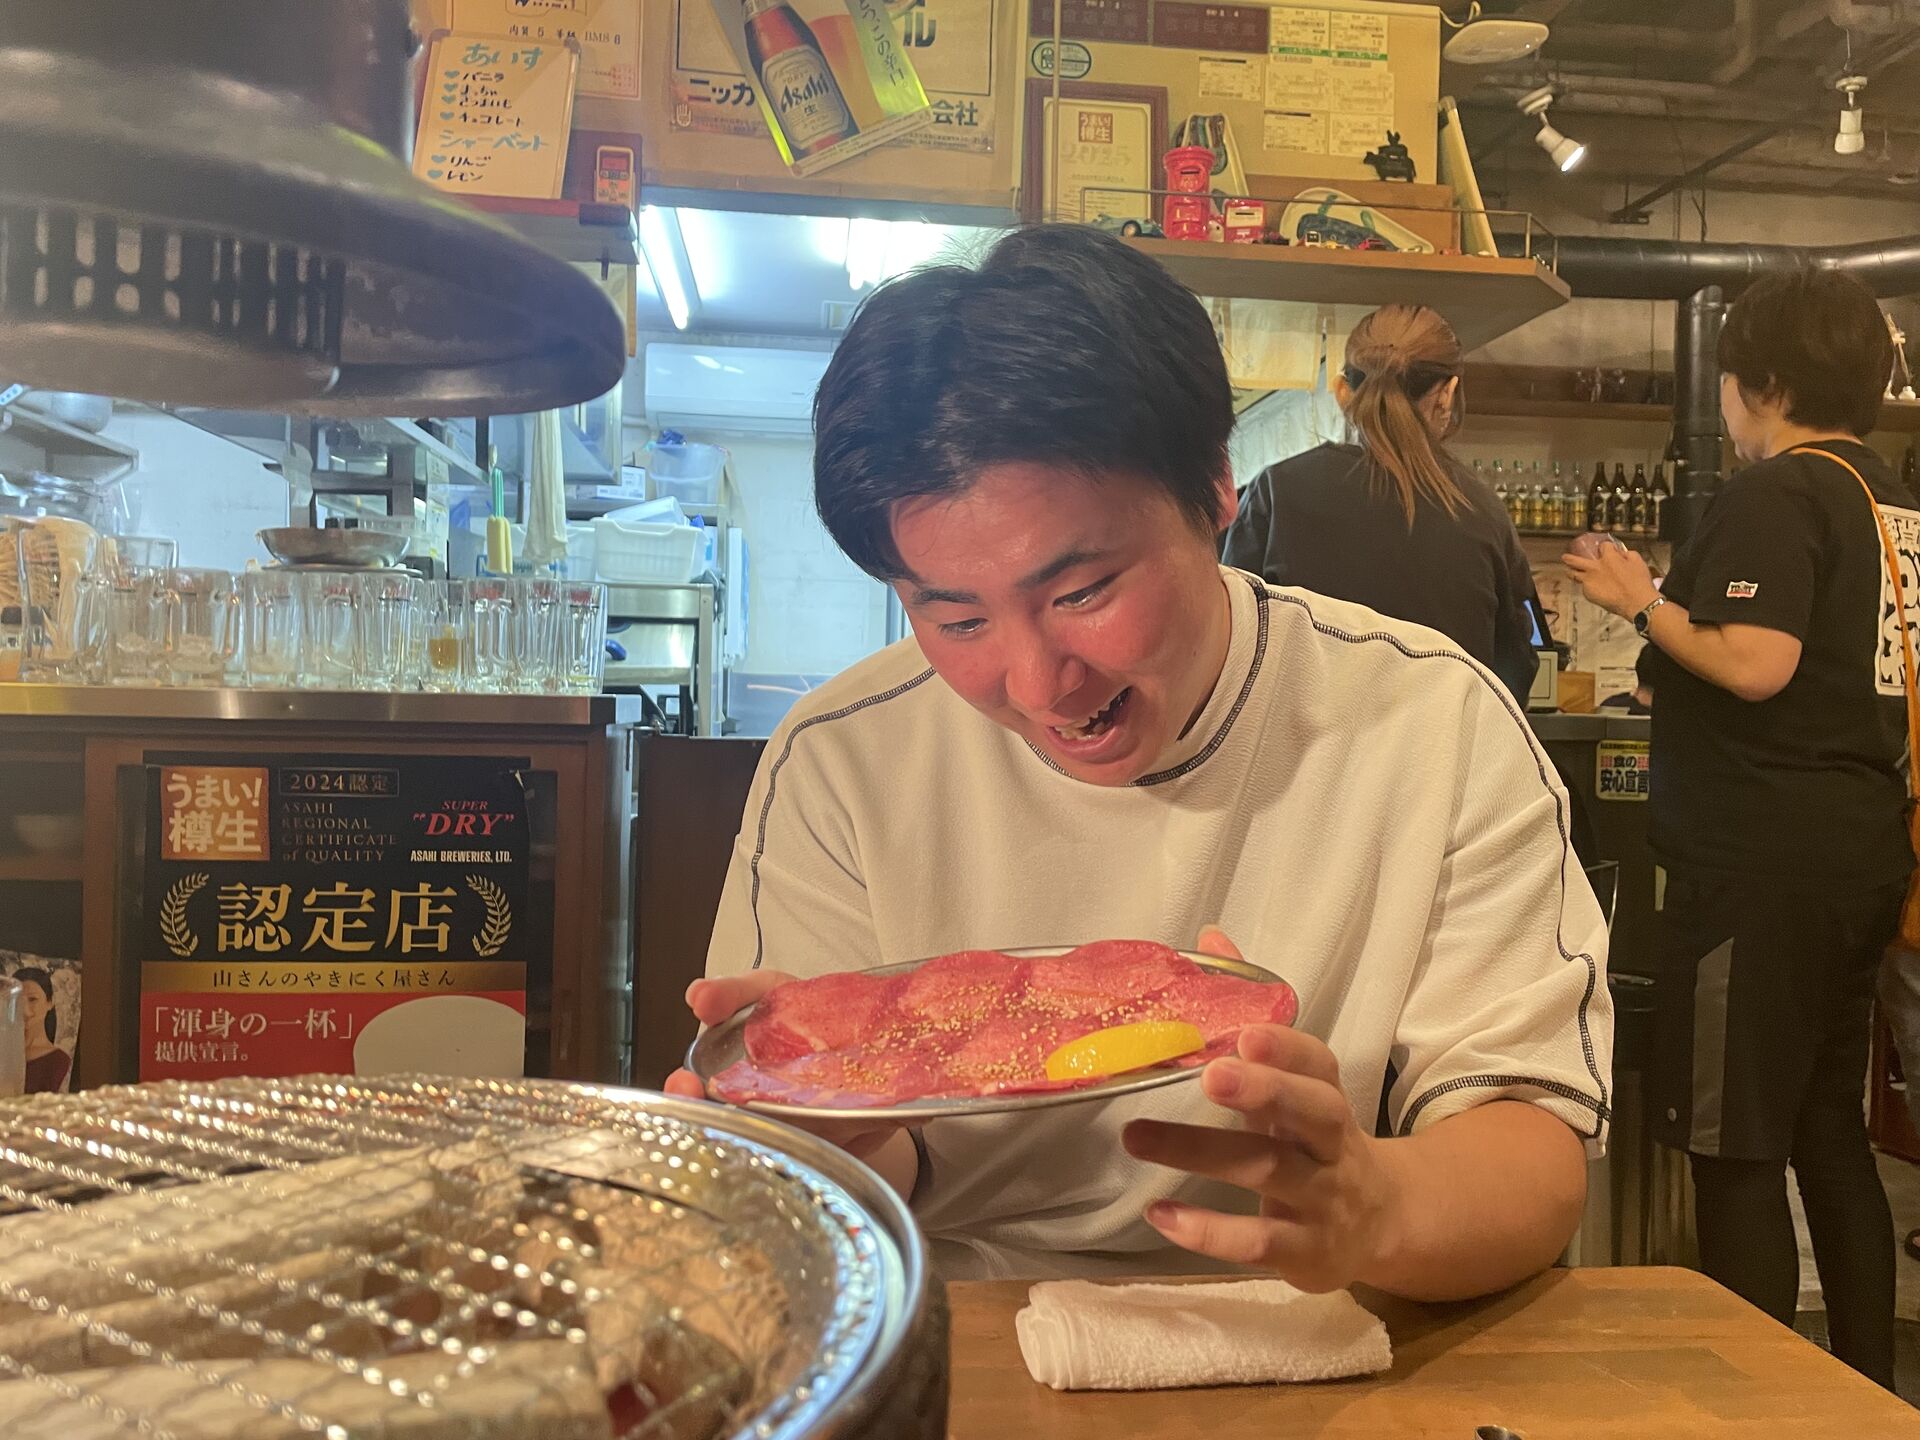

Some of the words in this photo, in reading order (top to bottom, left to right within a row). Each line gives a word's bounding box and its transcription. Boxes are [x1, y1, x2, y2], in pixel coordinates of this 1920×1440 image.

[462, 43, 544, 71] あいす
[462, 71, 505, 83] バニラ
[780, 73, 830, 114] Asahi
[459, 96, 513, 109] さつまいも
[687, 78, 756, 106] ニッカ
[932, 99, 978, 126] 会社
[804, 104, 818, 117] 生
[458, 111, 523, 127] チョコレート
[440, 129, 549, 151] シャーベット
[450, 155, 492, 168] りんご
[446, 170, 483, 182] レモン
[1613, 755, 1637, 768] 食の
[290, 774, 388, 793] 2024認定
[1600, 768, 1649, 793] 安心宣言
[166, 773, 263, 808] うまい!
[282, 802, 334, 815] ASAHI
[441, 800, 489, 811] SUPER
[168, 809, 262, 854] 樽生
[281, 818, 371, 830] REGIONAL
[282, 834, 398, 846] CERTIFICATE
[282, 850, 298, 861] of
[305, 850, 385, 864] QUALITY
[410, 850, 437, 862] ASAHI
[440, 850, 493, 864] BREWERIES,
[495, 850, 513, 863] LTD.
[216, 881, 458, 954] 認定店
[212, 968, 456, 989] 山さんのやきにく屋さん
[154, 1006, 354, 1040] 「渾身の一杯」
[154, 1041, 250, 1063] 提供宣言。
